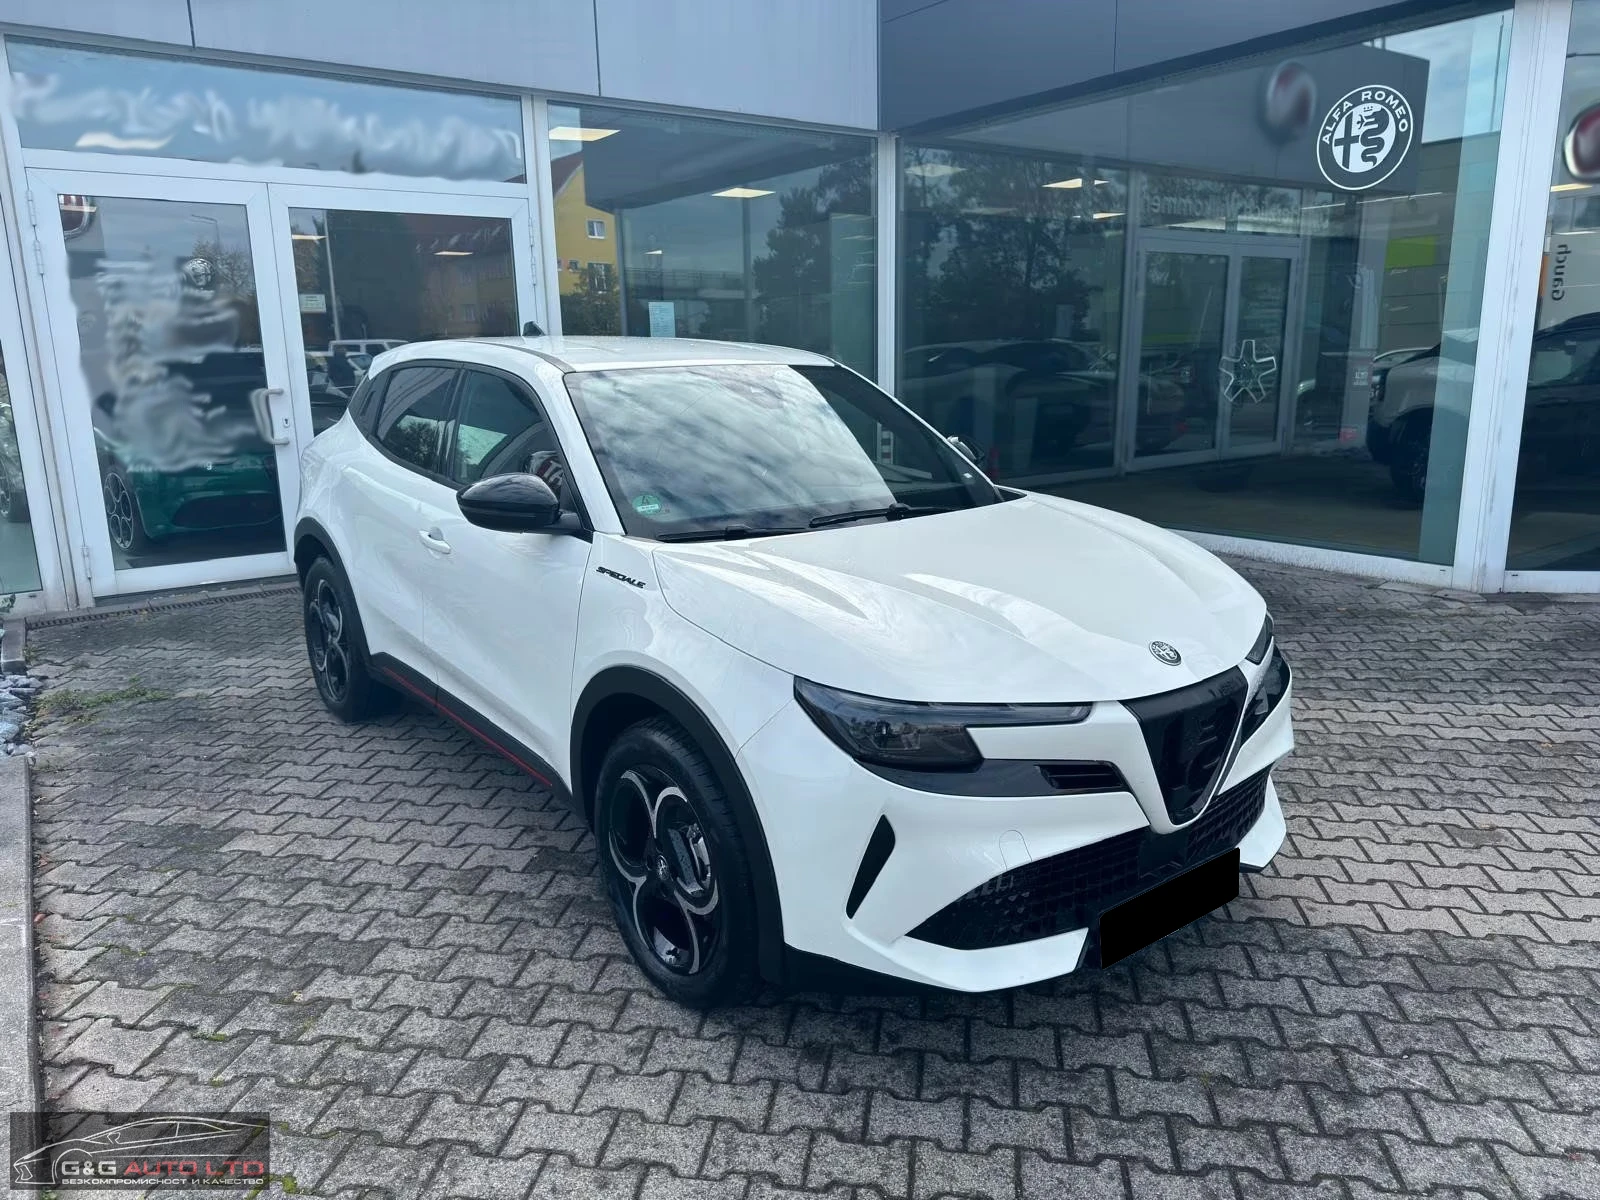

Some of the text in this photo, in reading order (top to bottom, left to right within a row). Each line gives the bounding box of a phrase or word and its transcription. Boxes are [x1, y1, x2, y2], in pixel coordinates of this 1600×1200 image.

[1322, 90, 1408, 144] ALFA ROMEO
[596, 566, 646, 589] SPECIALE
